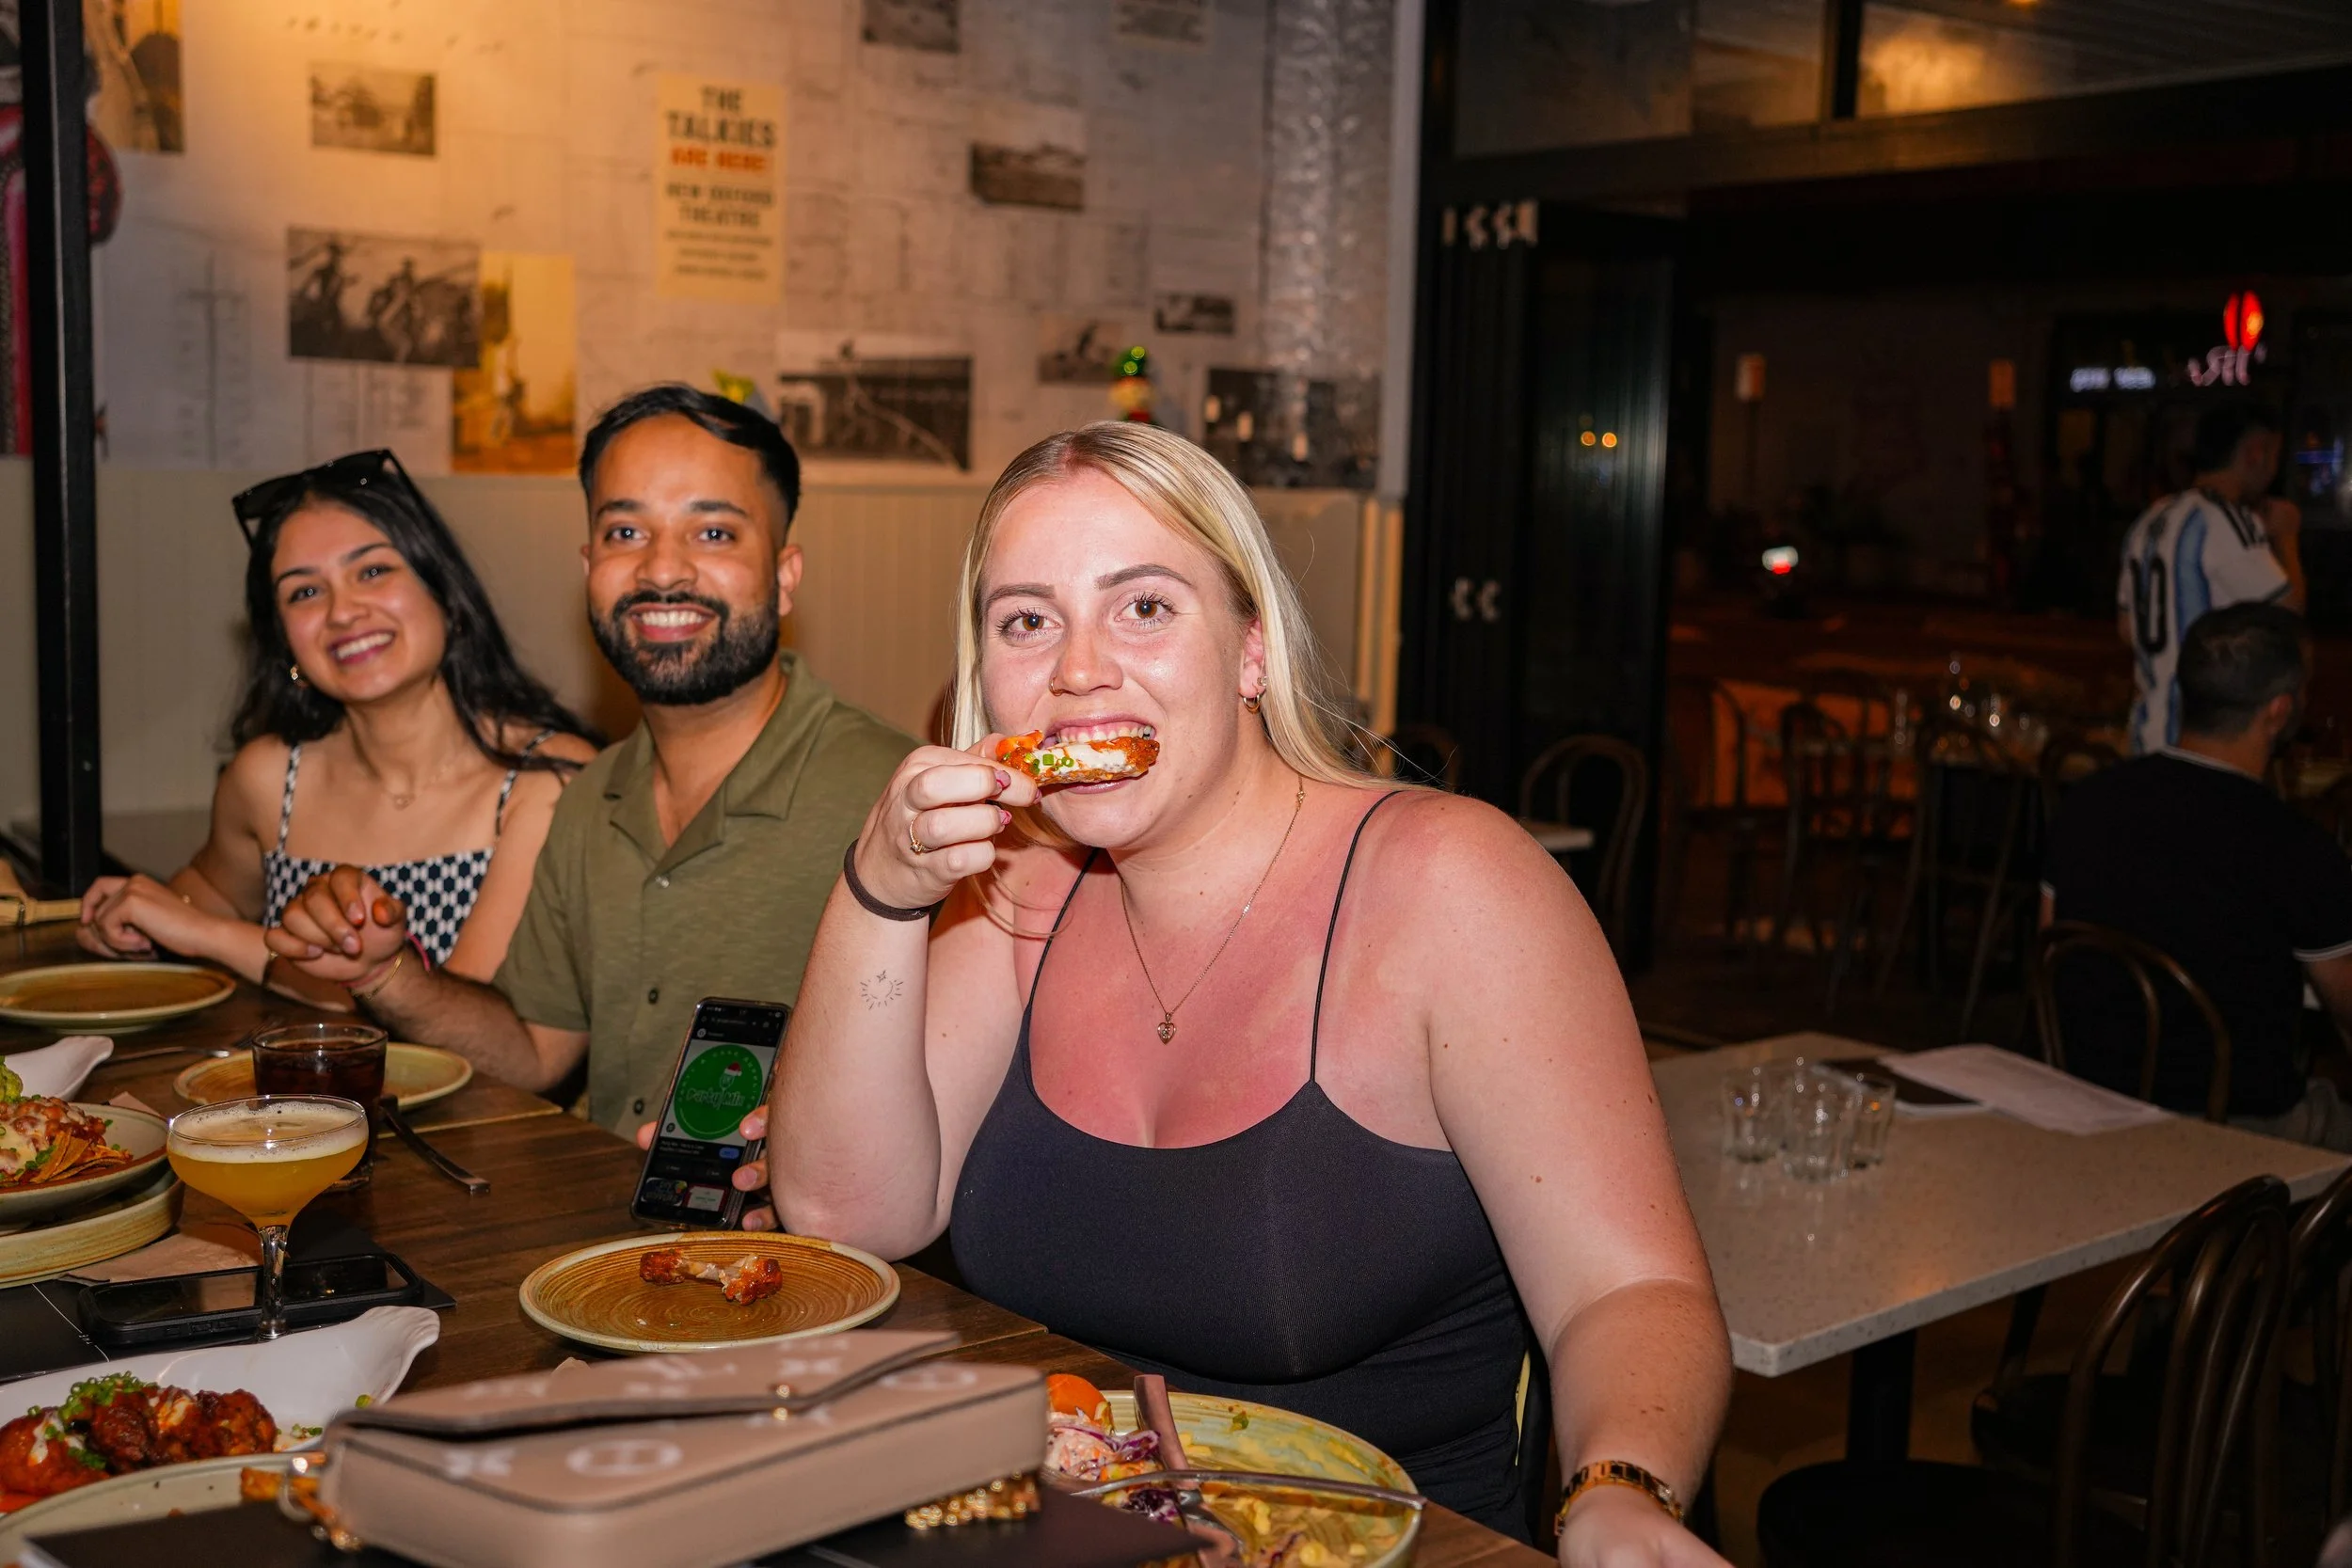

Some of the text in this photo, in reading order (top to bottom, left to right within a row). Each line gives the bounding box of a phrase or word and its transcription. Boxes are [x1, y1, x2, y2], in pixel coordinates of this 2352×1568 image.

[702, 86, 741, 112] THE
[666, 110, 776, 148] TALKIES
[2130, 558, 2167, 652] 10
